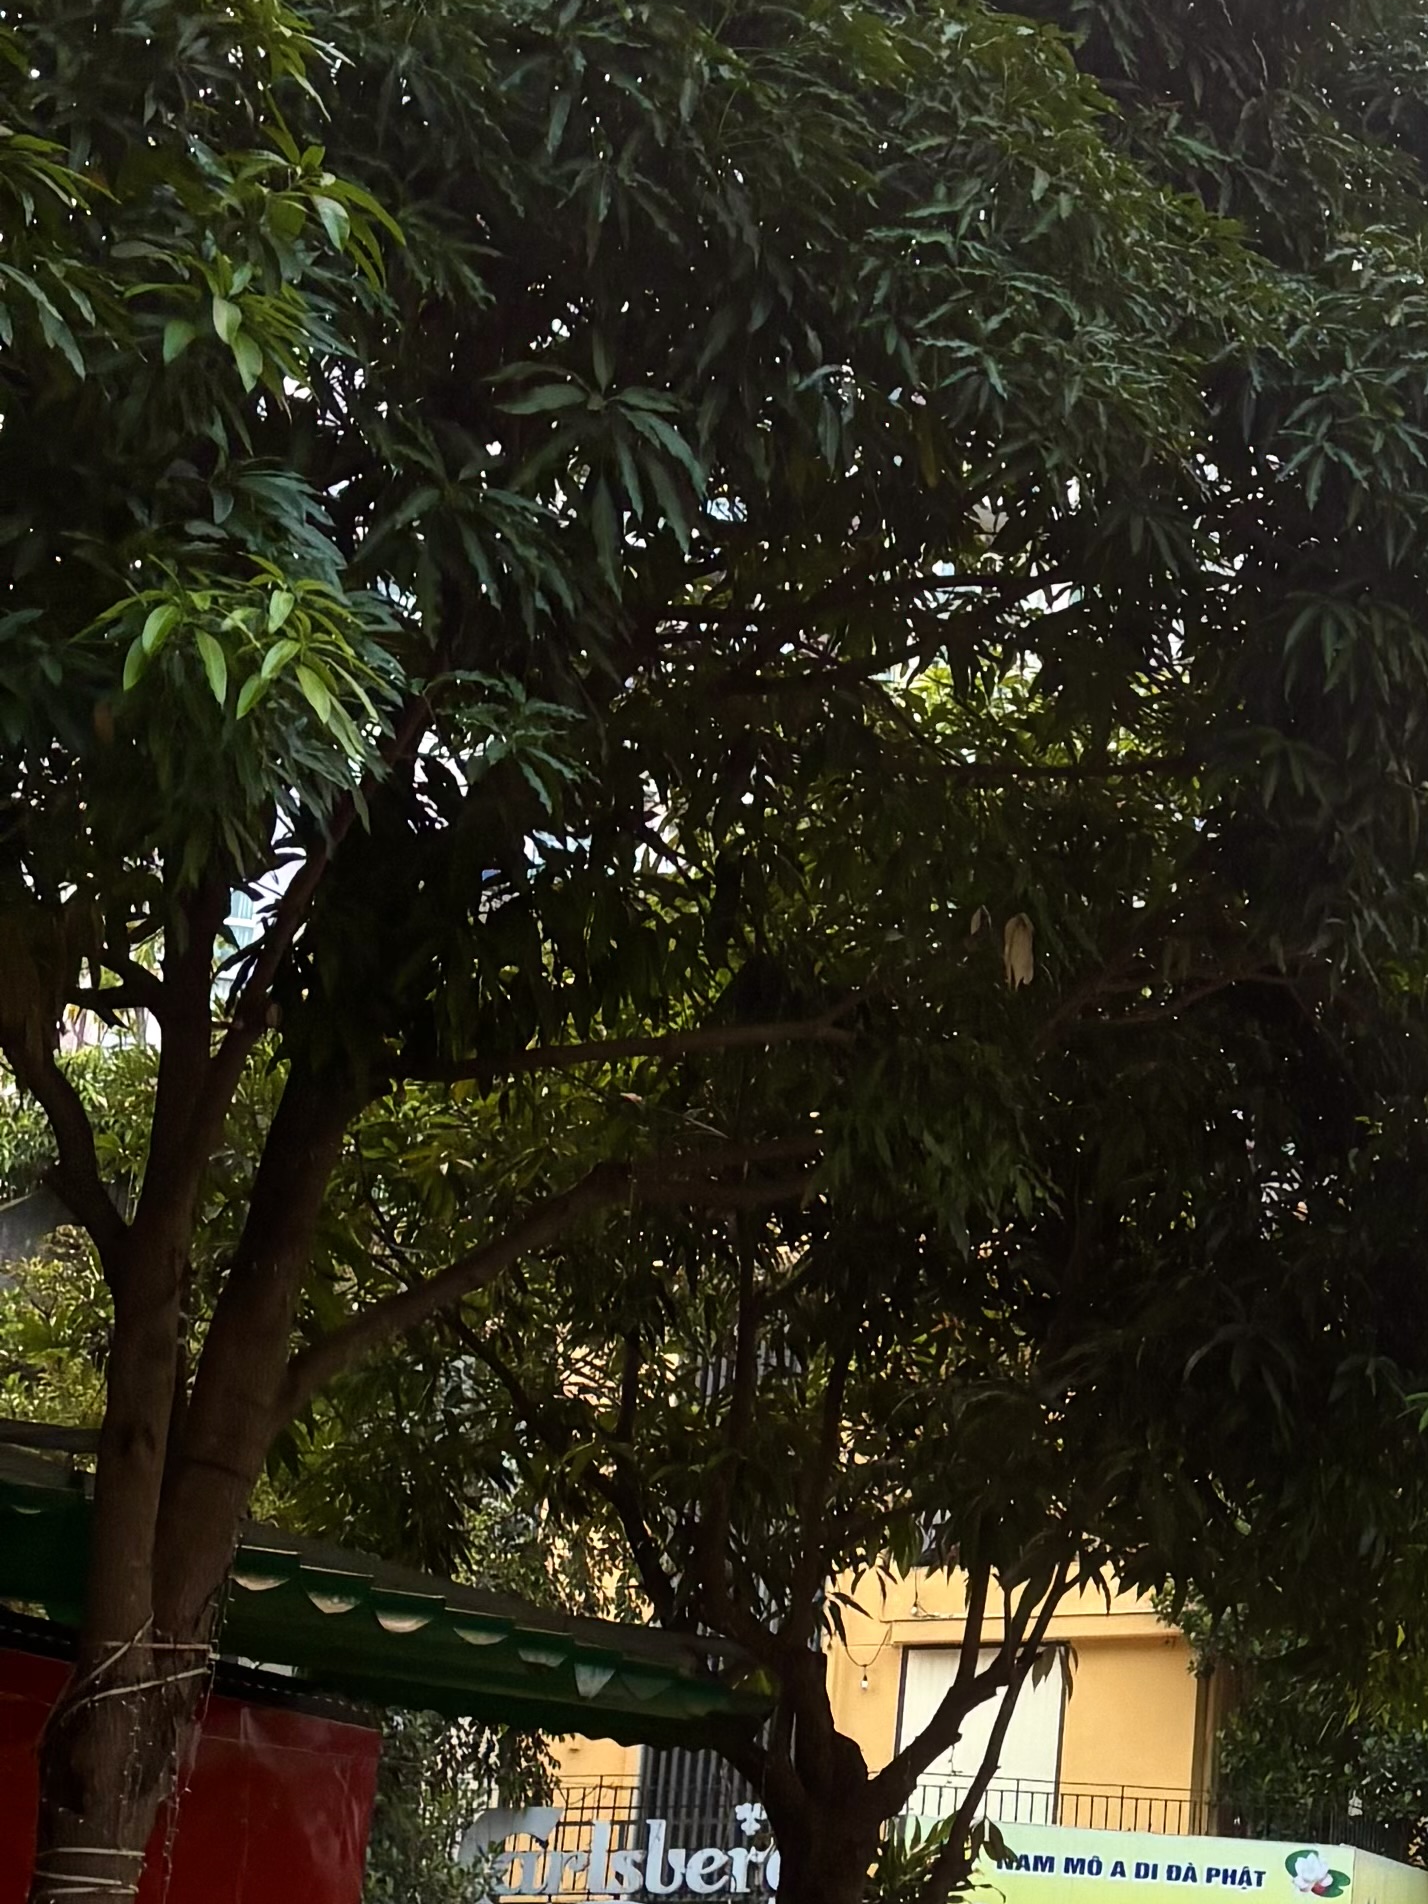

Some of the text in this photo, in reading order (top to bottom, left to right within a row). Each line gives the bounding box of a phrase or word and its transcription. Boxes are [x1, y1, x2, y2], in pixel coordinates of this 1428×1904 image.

[997, 1853, 1267, 1891] NAM MÔ A DI ĐÀ PHẬT
